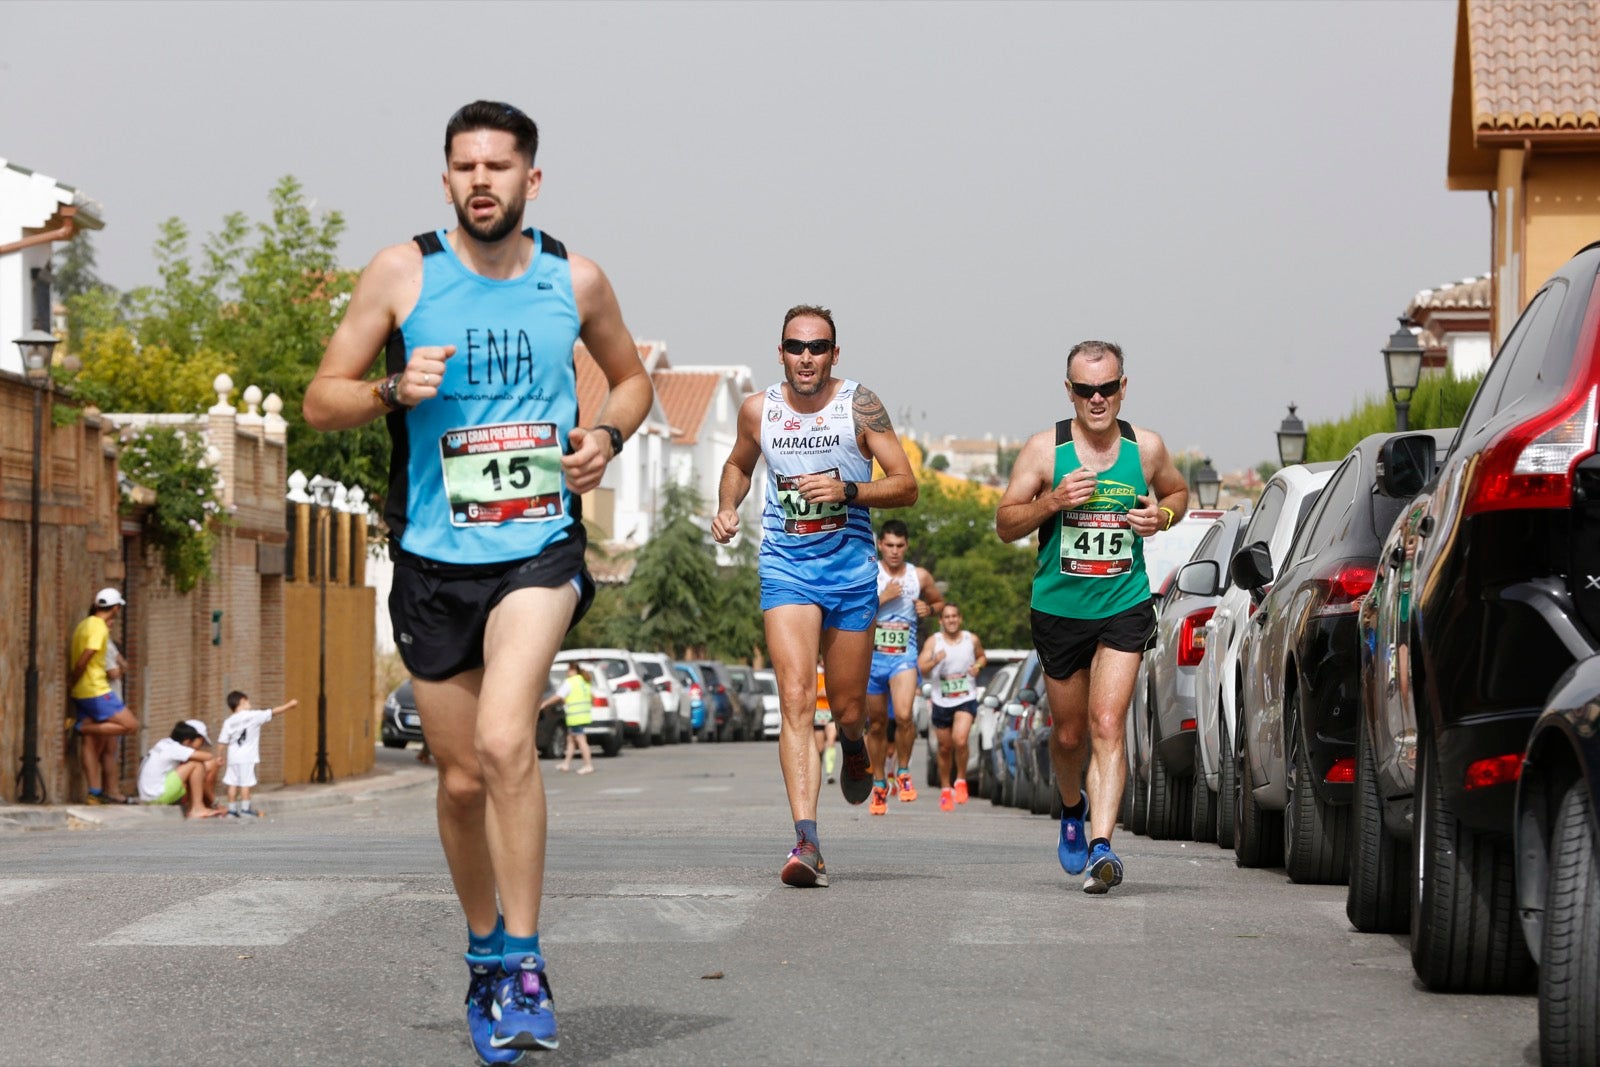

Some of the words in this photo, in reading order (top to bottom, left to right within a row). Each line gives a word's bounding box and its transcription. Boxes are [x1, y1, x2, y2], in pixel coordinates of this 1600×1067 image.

[466, 328, 533, 386] ENA
[467, 428, 489, 444] GRAN
[489, 425, 519, 441] PREMIO
[518, 424, 530, 438] DE
[772, 434, 840, 449] MARACENA
[482, 456, 531, 491] 15
[1103, 487, 1136, 495] VERDE
[1079, 512, 1092, 521] GRAN
[1074, 531, 1124, 555] 415
[881, 631, 905, 644] 193
